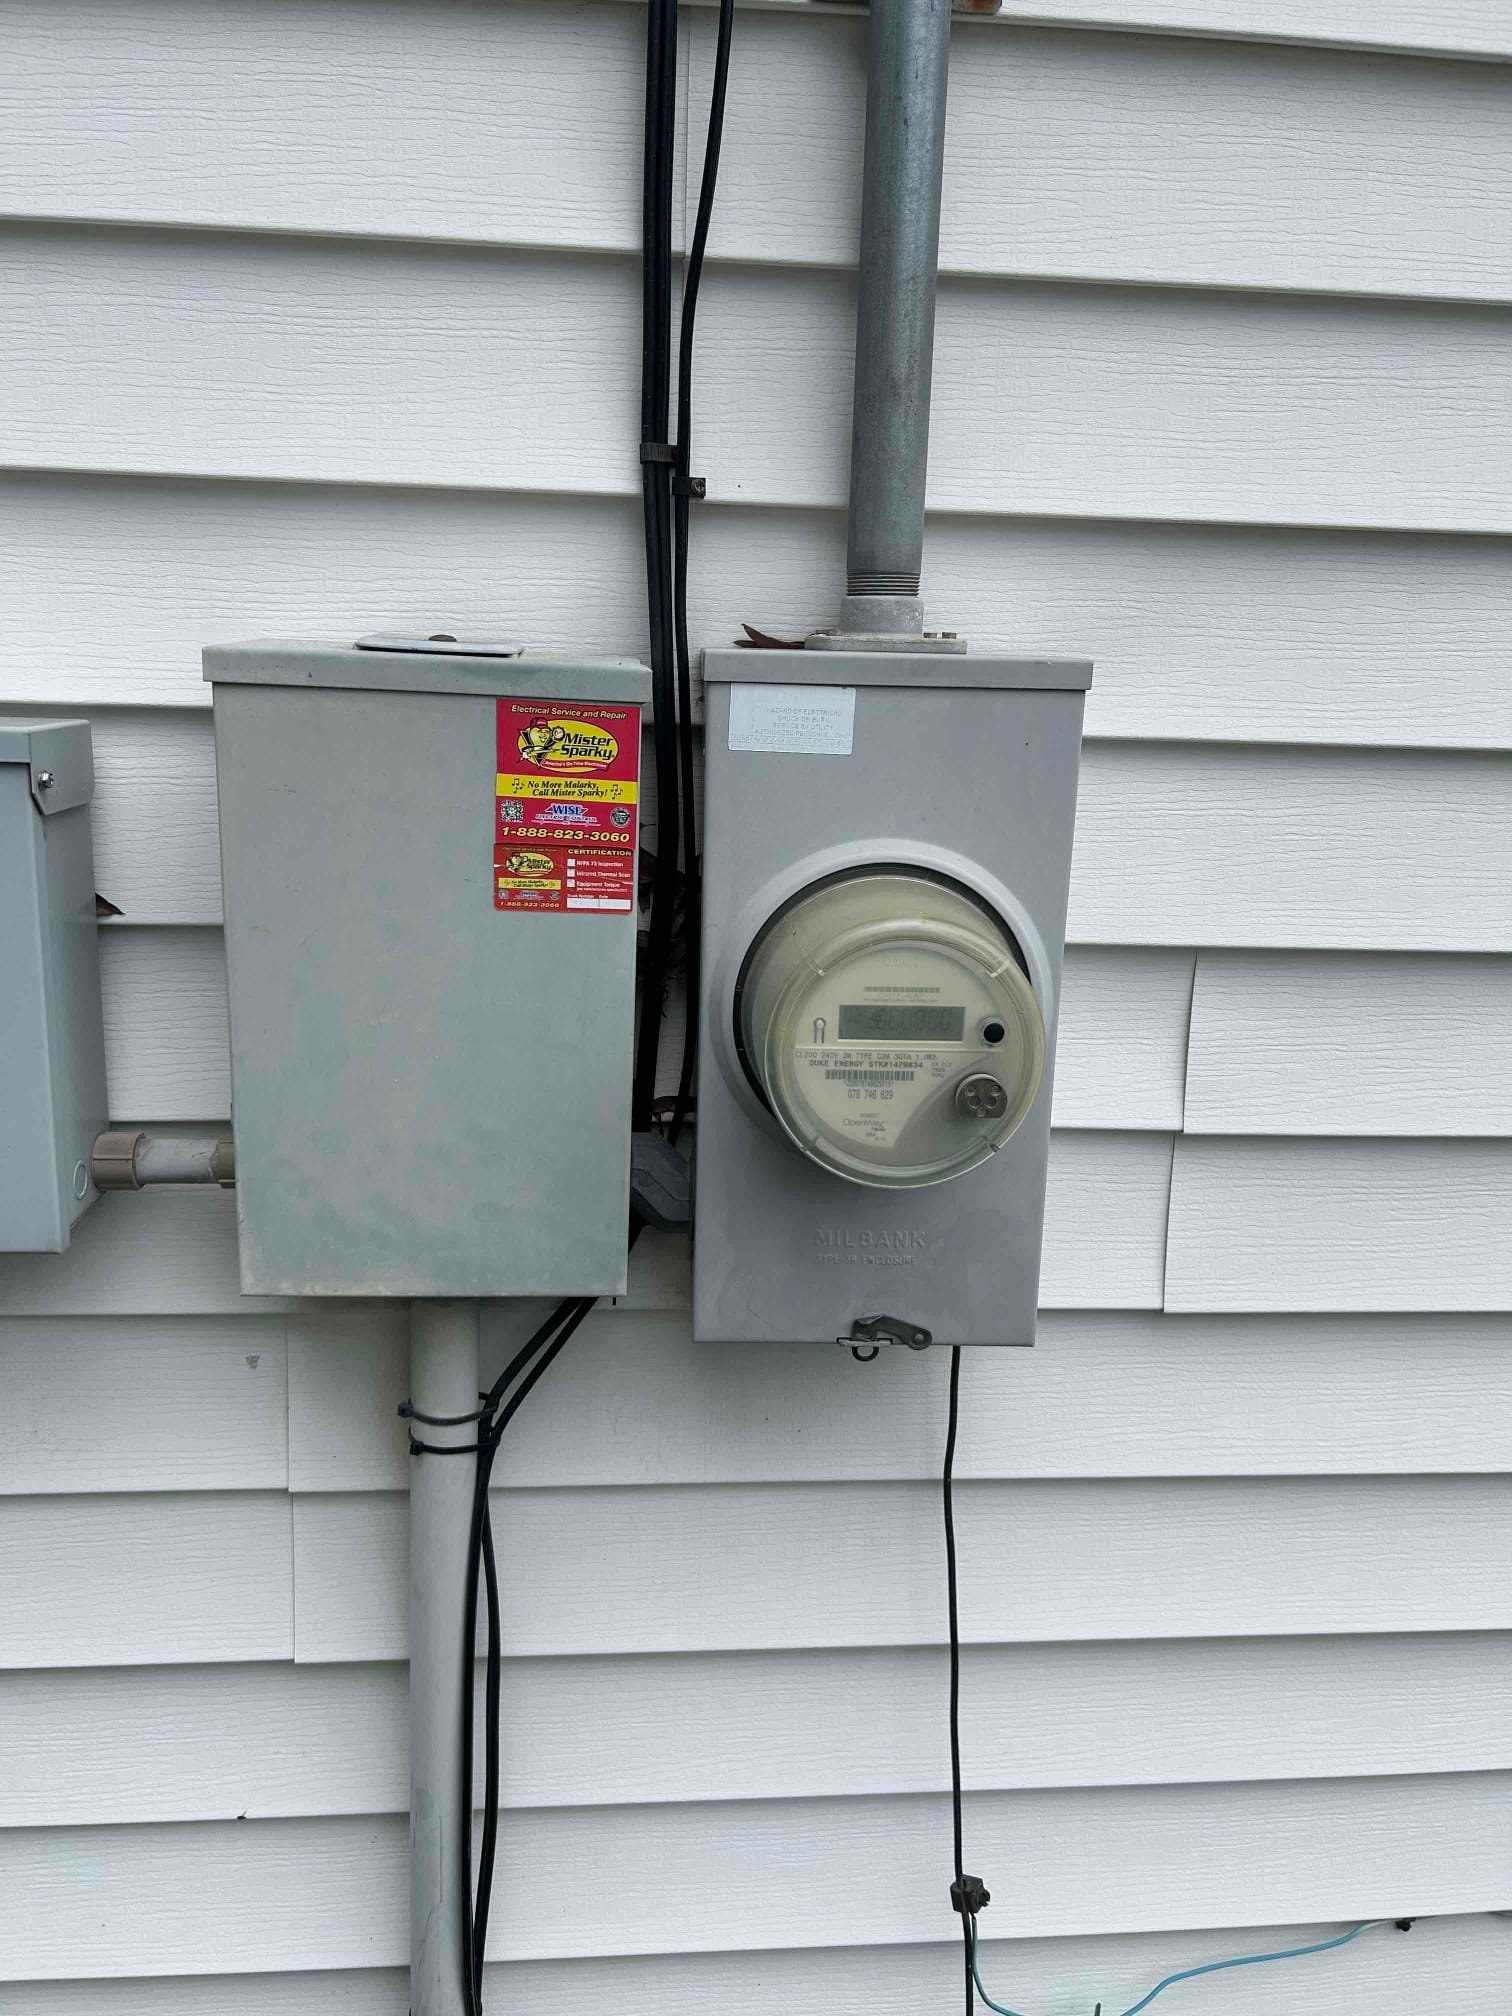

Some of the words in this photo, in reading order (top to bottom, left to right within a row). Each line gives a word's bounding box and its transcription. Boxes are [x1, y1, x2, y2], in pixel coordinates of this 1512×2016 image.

[511, 704, 549, 714] Electrical
[551, 707, 580, 717] Service
[583, 709, 600, 718] and
[600, 711, 627, 720] Repair
[564, 733, 613, 747] Mister
[527, 780, 541, 788] No
[541, 781, 562, 790] More
[563, 782, 599, 793] Malarky,
[532, 788, 548, 796] Call
[549, 789, 577, 798] Mister
[577, 789, 609, 799] Sparky!
[552, 804, 582, 815] WISE
[501, 826, 630, 842] 1-888-823-3060
[568, 848, 632, 856] CERTIFICATION
[834, 1060, 863, 1068] ENERGY
[814, 1228, 927, 1249] MILBANK
[861, 1254, 920, 1266] ENCLOSURE
